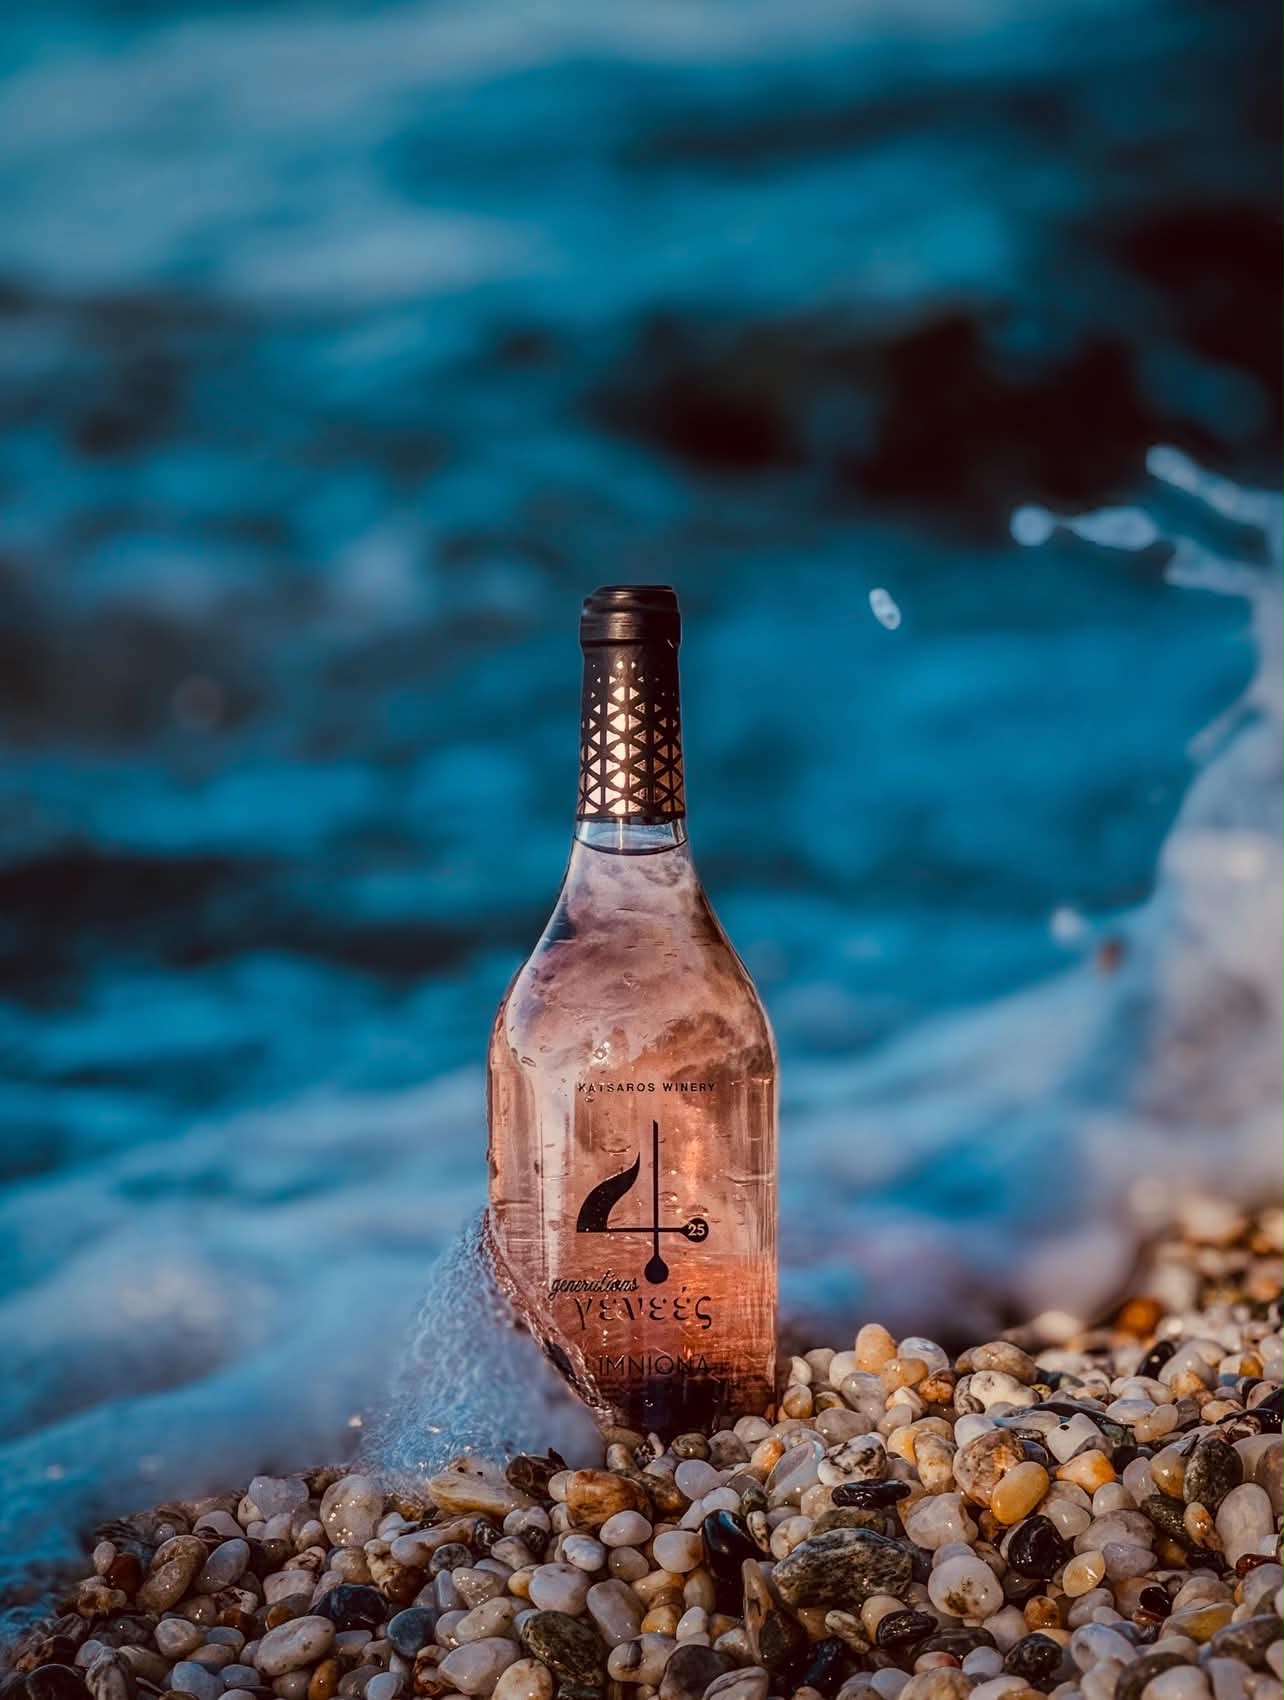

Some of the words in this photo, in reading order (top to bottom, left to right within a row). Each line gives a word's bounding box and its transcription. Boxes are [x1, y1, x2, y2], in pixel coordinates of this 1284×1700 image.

[577, 1082, 656, 1092] KATSAROS
[663, 1082, 715, 1092] WINERY
[688, 1224, 705, 1236] 25
[548, 1270, 640, 1299] generations
[597, 1355, 709, 1377] IMNIONA
